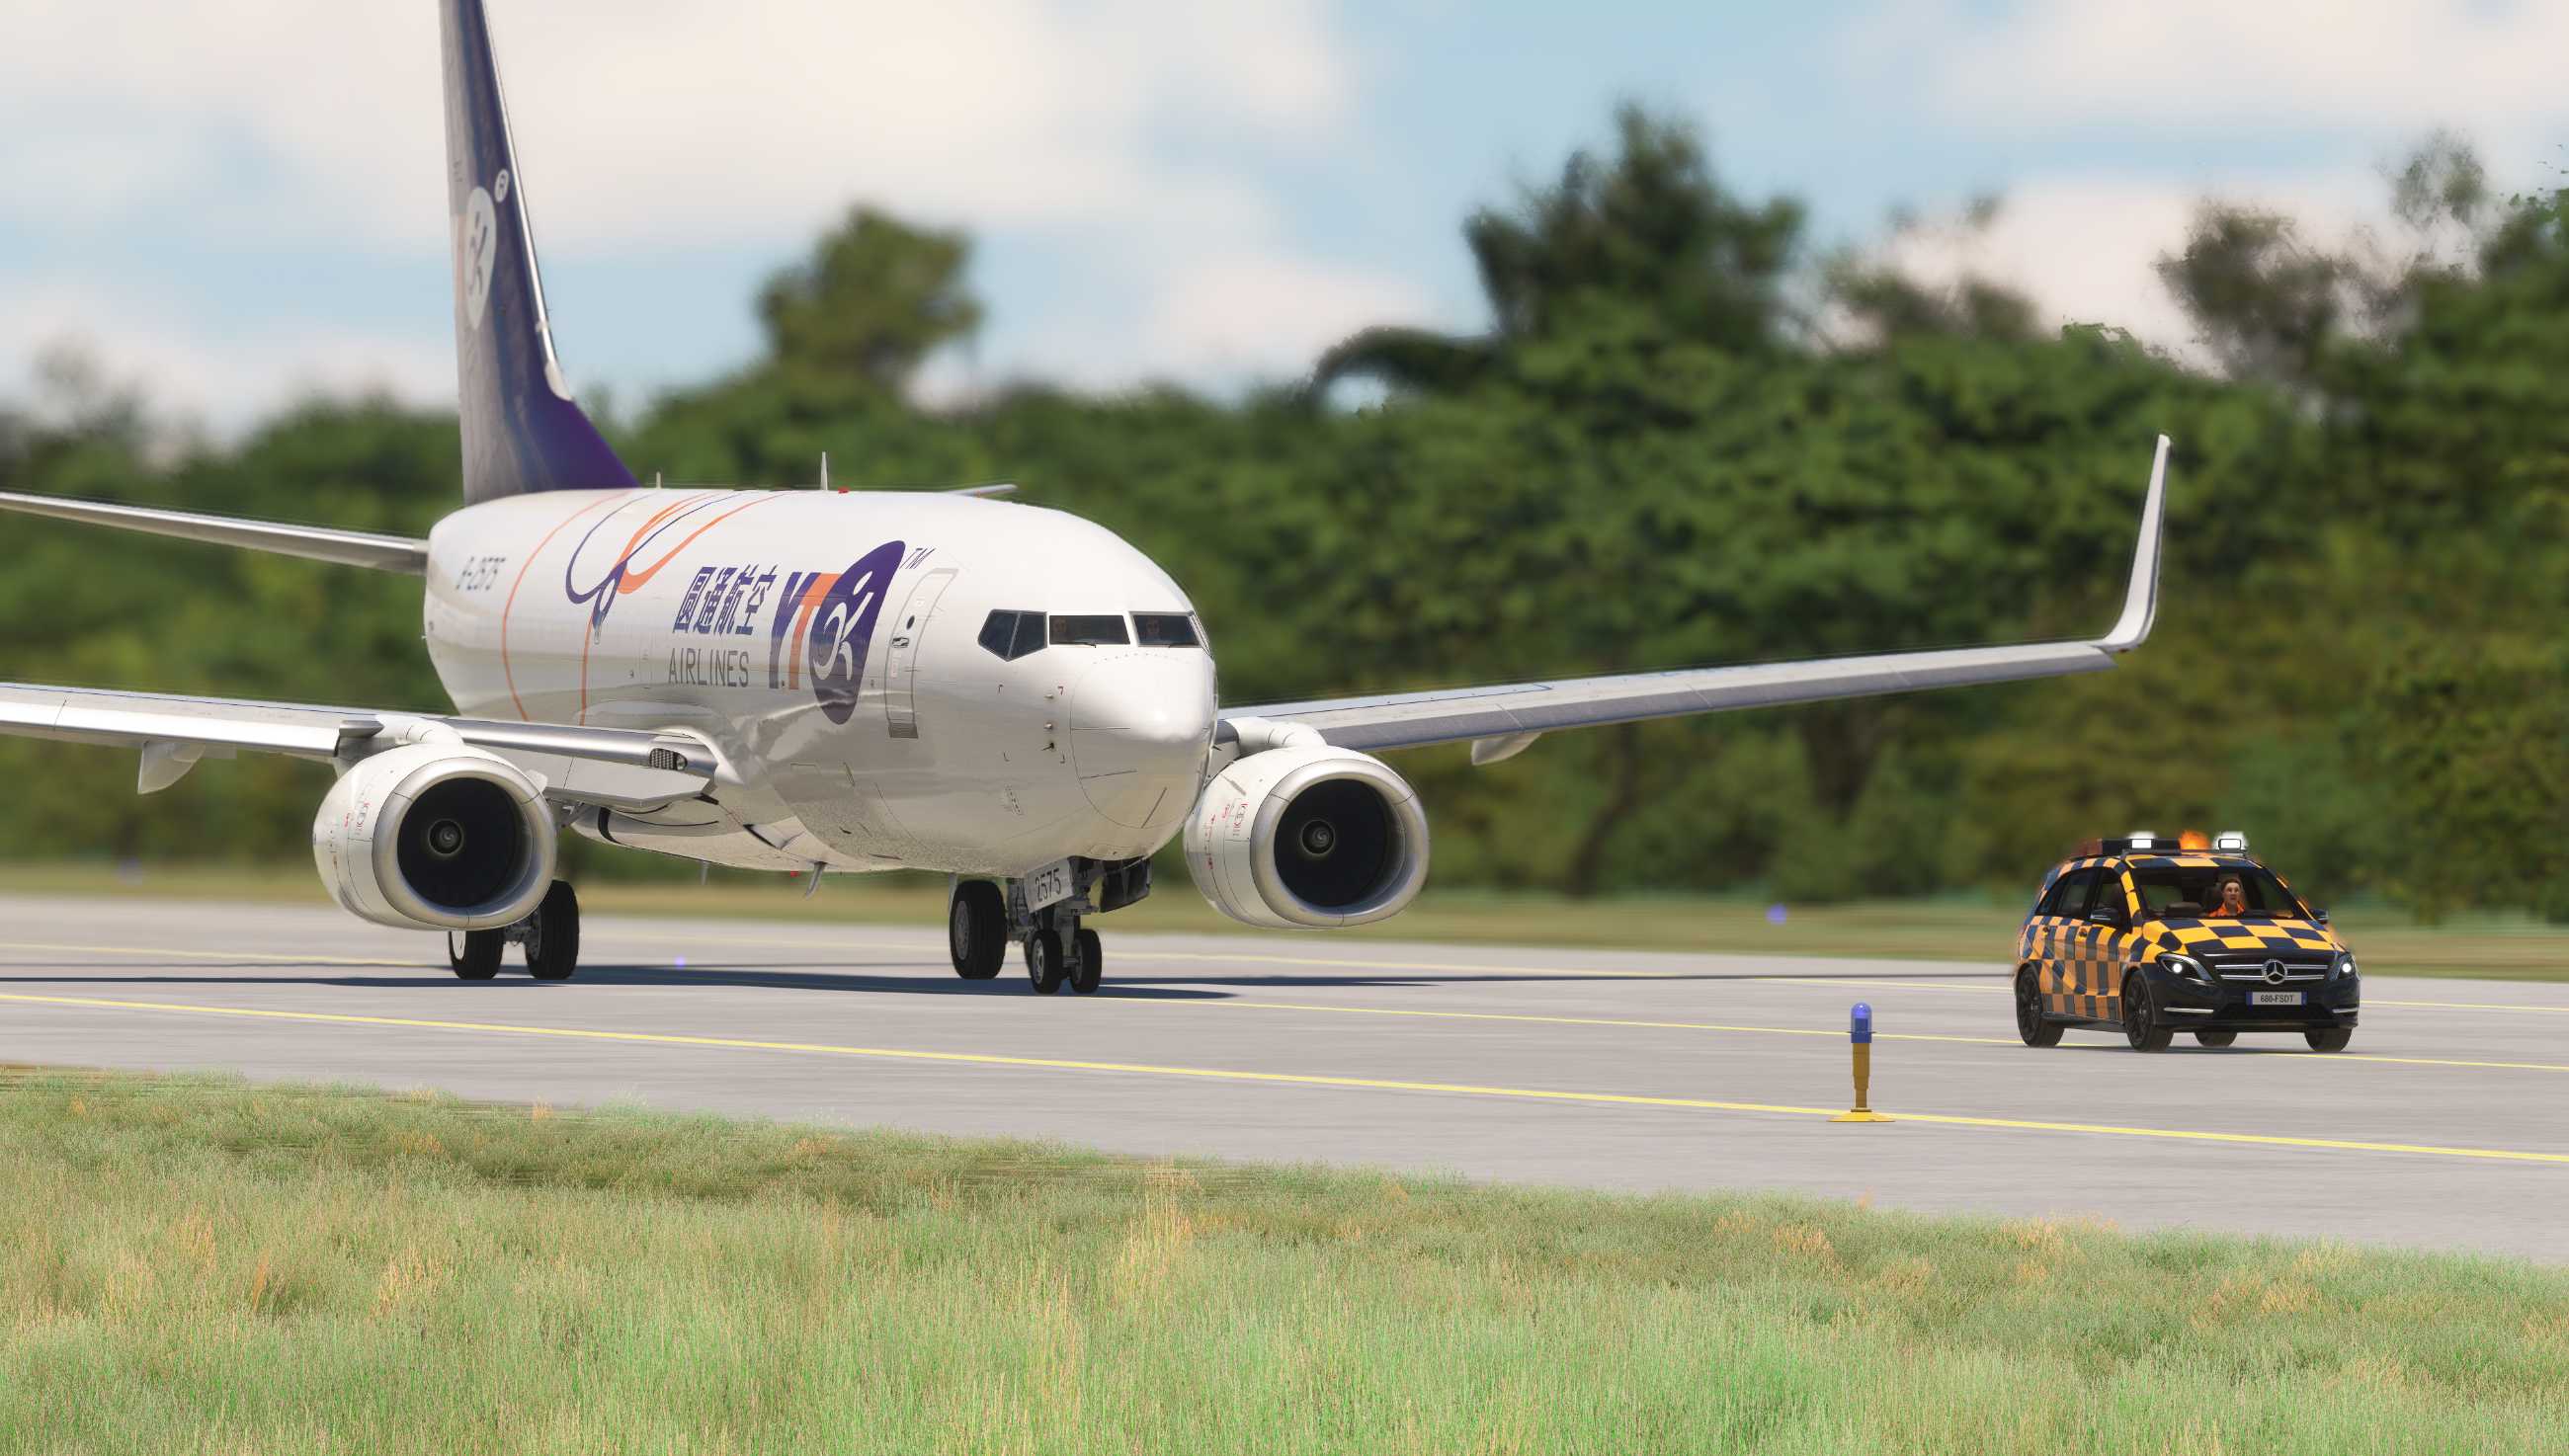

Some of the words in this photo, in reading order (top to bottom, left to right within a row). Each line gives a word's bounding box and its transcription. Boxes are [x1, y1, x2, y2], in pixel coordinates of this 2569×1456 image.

[672, 564, 779, 637] 圆通航空
[668, 647, 750, 688] AIRLINES
[1035, 867, 1061, 902] 2575
